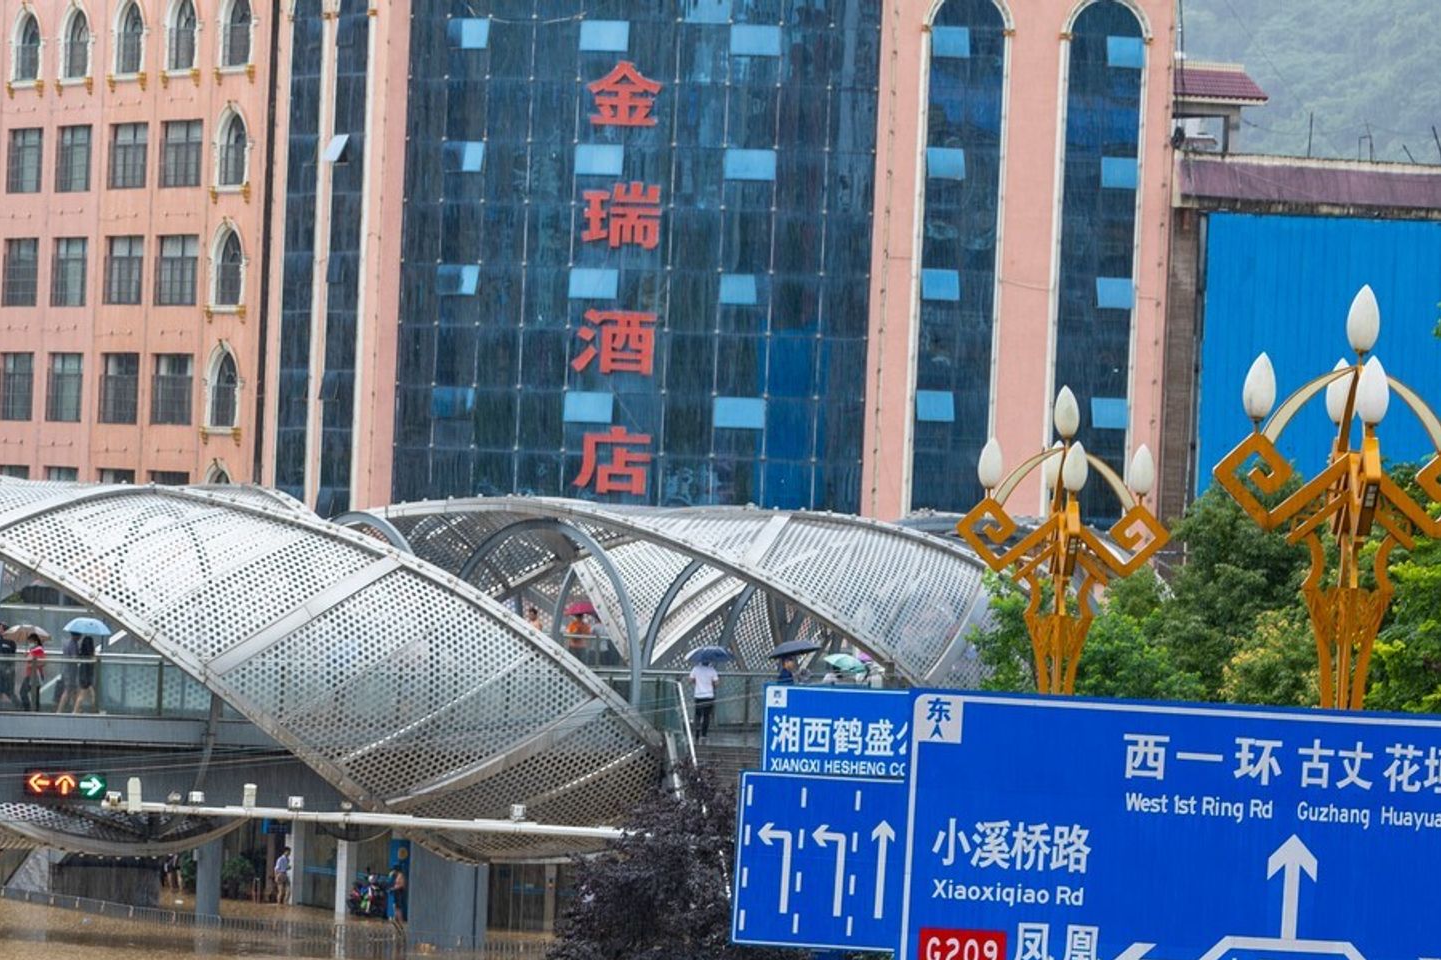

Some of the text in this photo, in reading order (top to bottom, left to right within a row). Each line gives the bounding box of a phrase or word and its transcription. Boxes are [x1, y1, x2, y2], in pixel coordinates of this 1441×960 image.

[571, 60, 662, 494] 金瑞酒店
[927, 697, 952, 723] 东
[770, 758, 821, 773] XIANGXI
[824, 760, 886, 776] HESHENG
[1123, 733, 1283, 786] 西一环
[1297, 738, 1374, 790] 古丈
[1125, 792, 1168, 814] West
[1173, 795, 1197, 816] 1st
[1201, 796, 1244, 823] Ring
[1249, 799, 1274, 819] Rd
[1296, 801, 1370, 829] Guzhang
[932, 817, 1092, 874] 小溪桥路
[931, 879, 1084, 907] Xiaoxiqiao Rd
